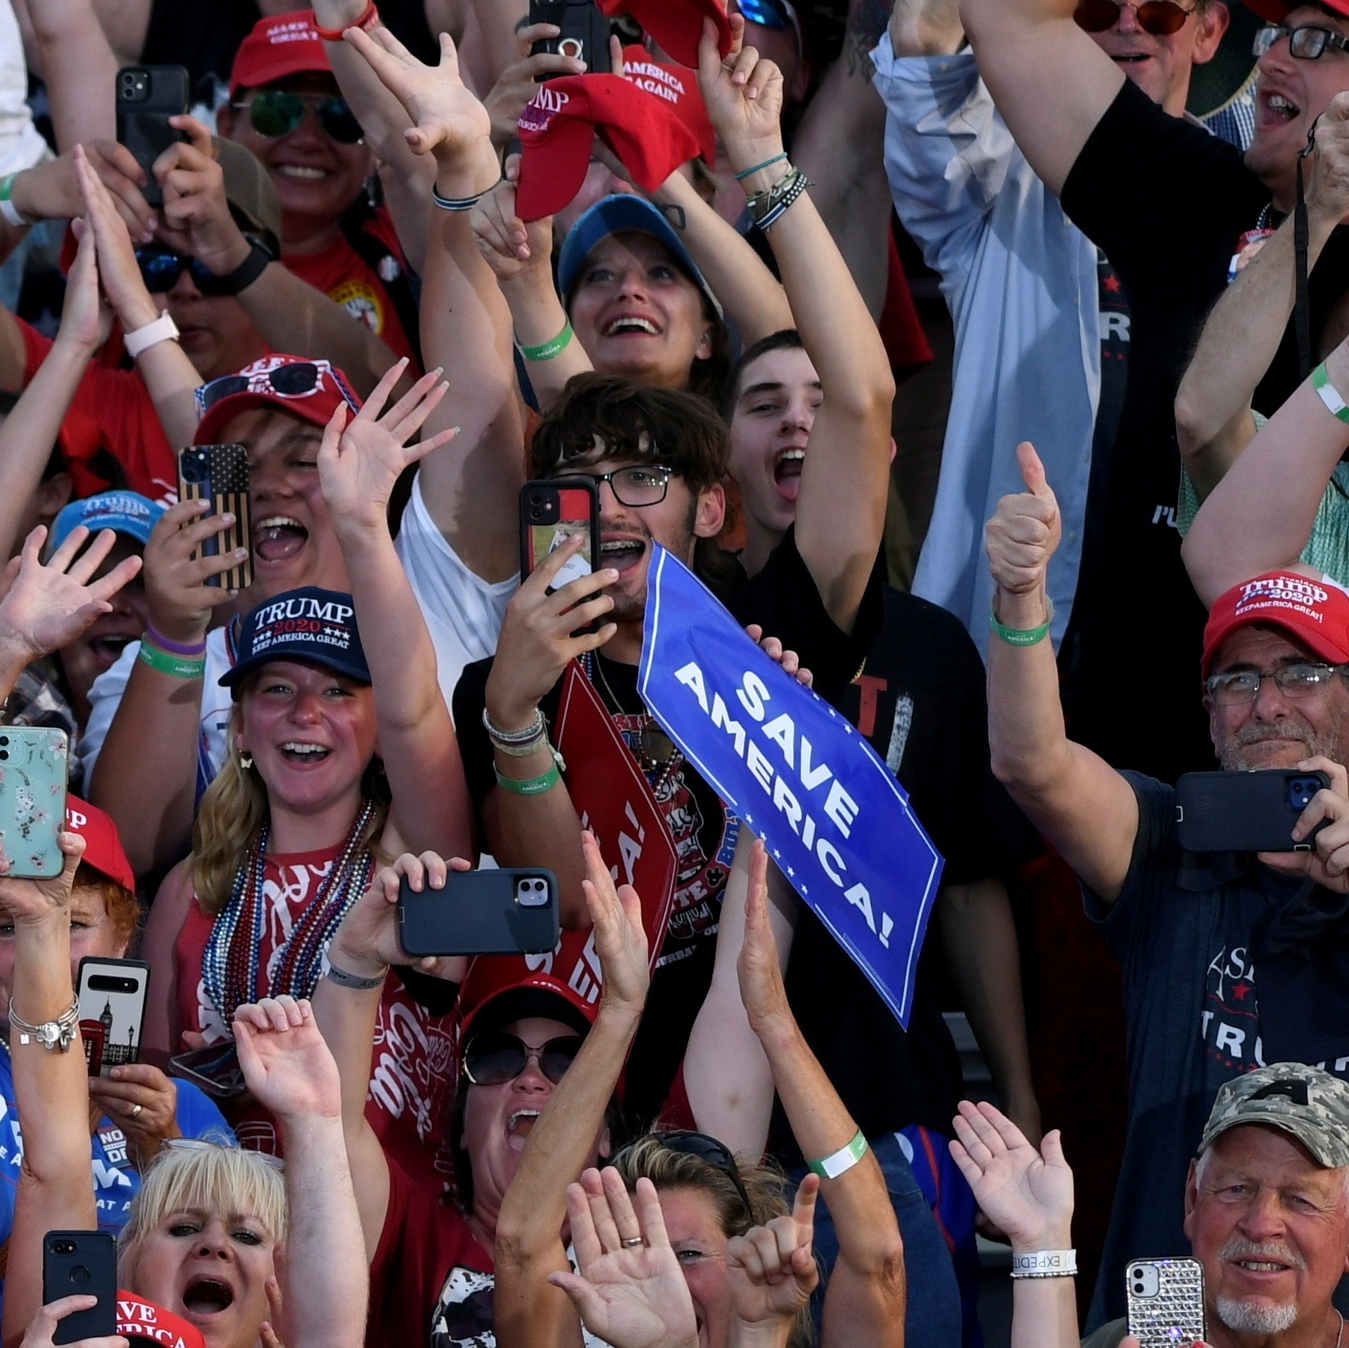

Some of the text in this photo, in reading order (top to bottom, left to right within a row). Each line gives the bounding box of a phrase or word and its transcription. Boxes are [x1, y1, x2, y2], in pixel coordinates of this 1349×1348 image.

[623, 60, 685, 95] AMERICA
[637, 81, 679, 104] AGAIN
[1239, 580, 1328, 606] Trump
[1269, 588, 1316, 606] 2020
[254, 598, 353, 632] TRUMP
[1255, 600, 1291, 614] AMERICA
[273, 620, 321, 636] 2020
[251, 632, 349, 655] KEEP AMERICA GREAT
[734, 670, 860, 842] SAVE
[674, 660, 895, 950] AMERICA!
[116, 1300, 158, 1324] AVE
